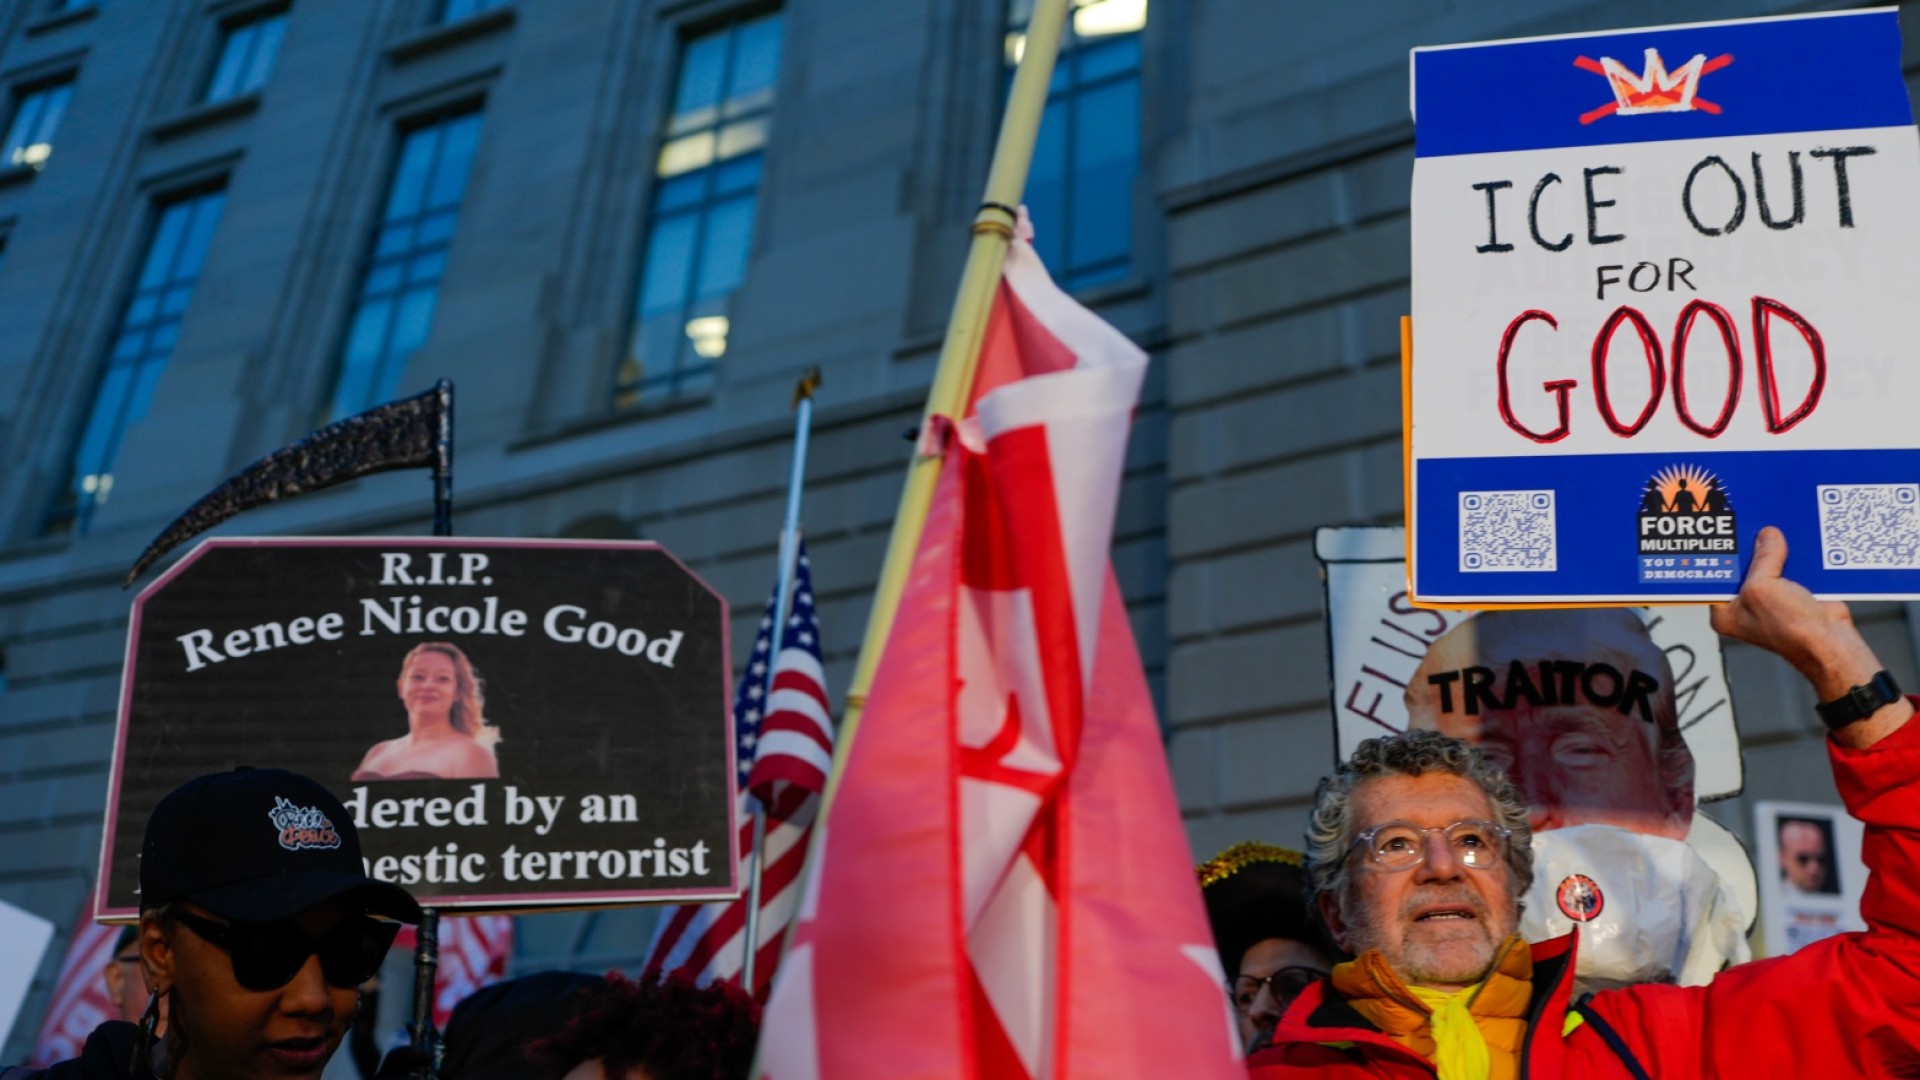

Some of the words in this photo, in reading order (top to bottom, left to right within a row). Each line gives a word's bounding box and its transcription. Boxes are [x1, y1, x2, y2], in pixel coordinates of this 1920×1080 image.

[1472, 166, 1626, 253] ICE
[1683, 146, 1877, 237] OUT
[1597, 258, 1697, 300] FOR
[1496, 295, 1826, 444] GOOD
[1641, 515, 1733, 535] FORCE
[1641, 538, 1734, 551] MULTIPLIER
[380, 552, 493, 586] R.I.P.
[1643, 558, 1675, 567] YOU
[1694, 558, 1719, 567] ME
[1643, 569, 1733, 579] DEMOCRACY
[177, 612, 344, 671] Renee
[360, 596, 528, 637] Nicole
[544, 604, 684, 668] Good
[1427, 659, 1660, 723] TRAITOR
[343, 783, 488, 828] dered
[504, 786, 565, 834] by
[580, 794, 638, 823] an
[364, 842, 485, 884] estic
[502, 837, 710, 883] terrorist
